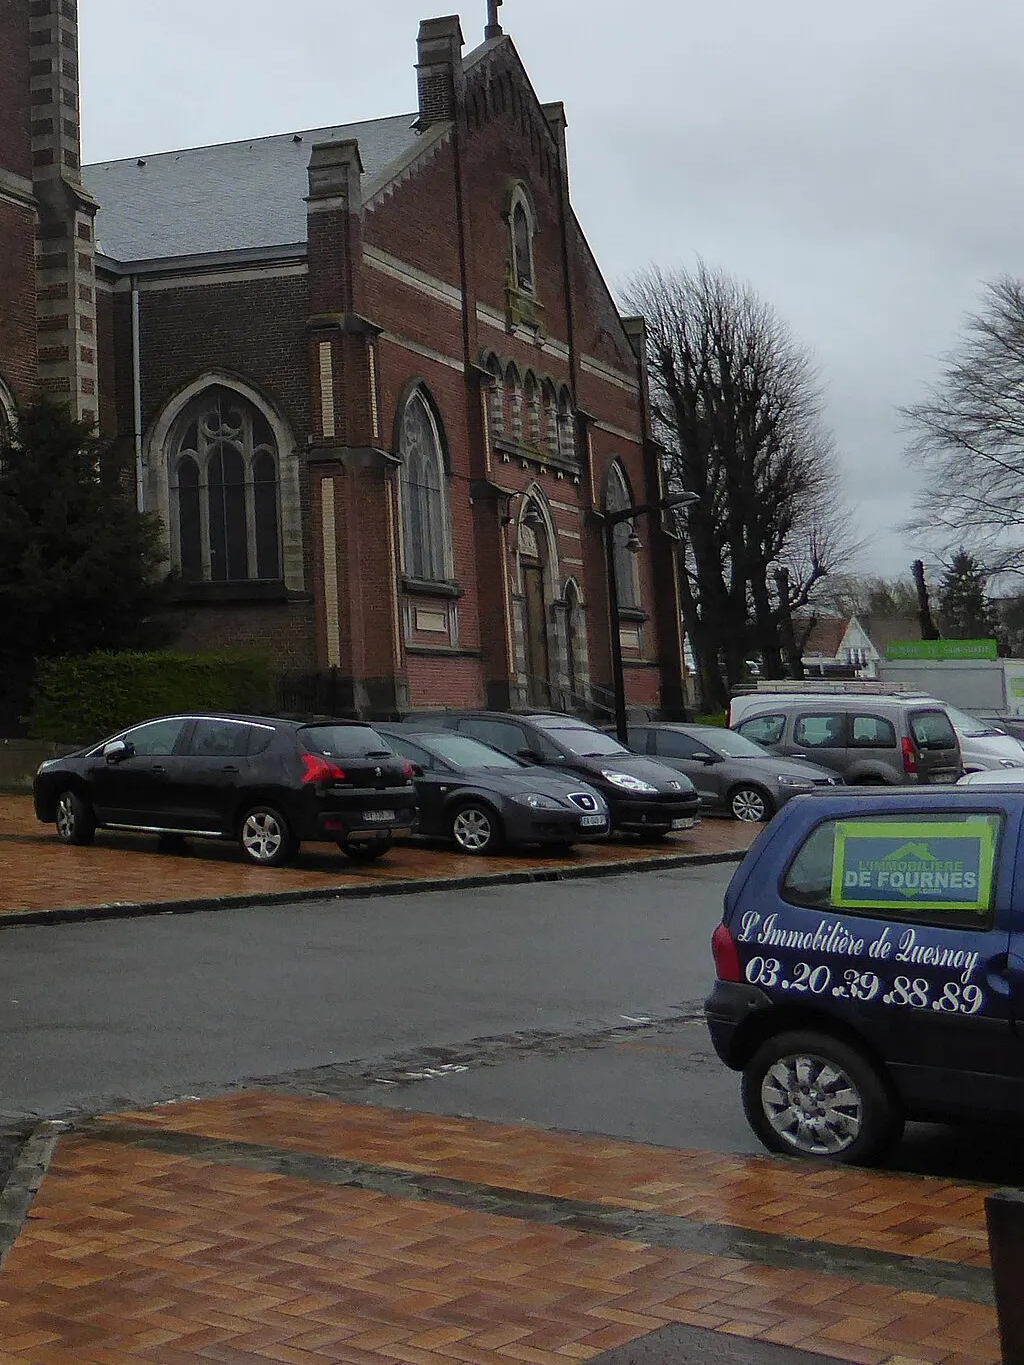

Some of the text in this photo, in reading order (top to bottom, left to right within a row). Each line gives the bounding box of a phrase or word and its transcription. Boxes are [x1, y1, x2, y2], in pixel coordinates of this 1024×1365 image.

[845, 871, 976, 888] DE FOURNES
[869, 926, 891, 959] de
[896, 928, 979, 984] Quesnoy
